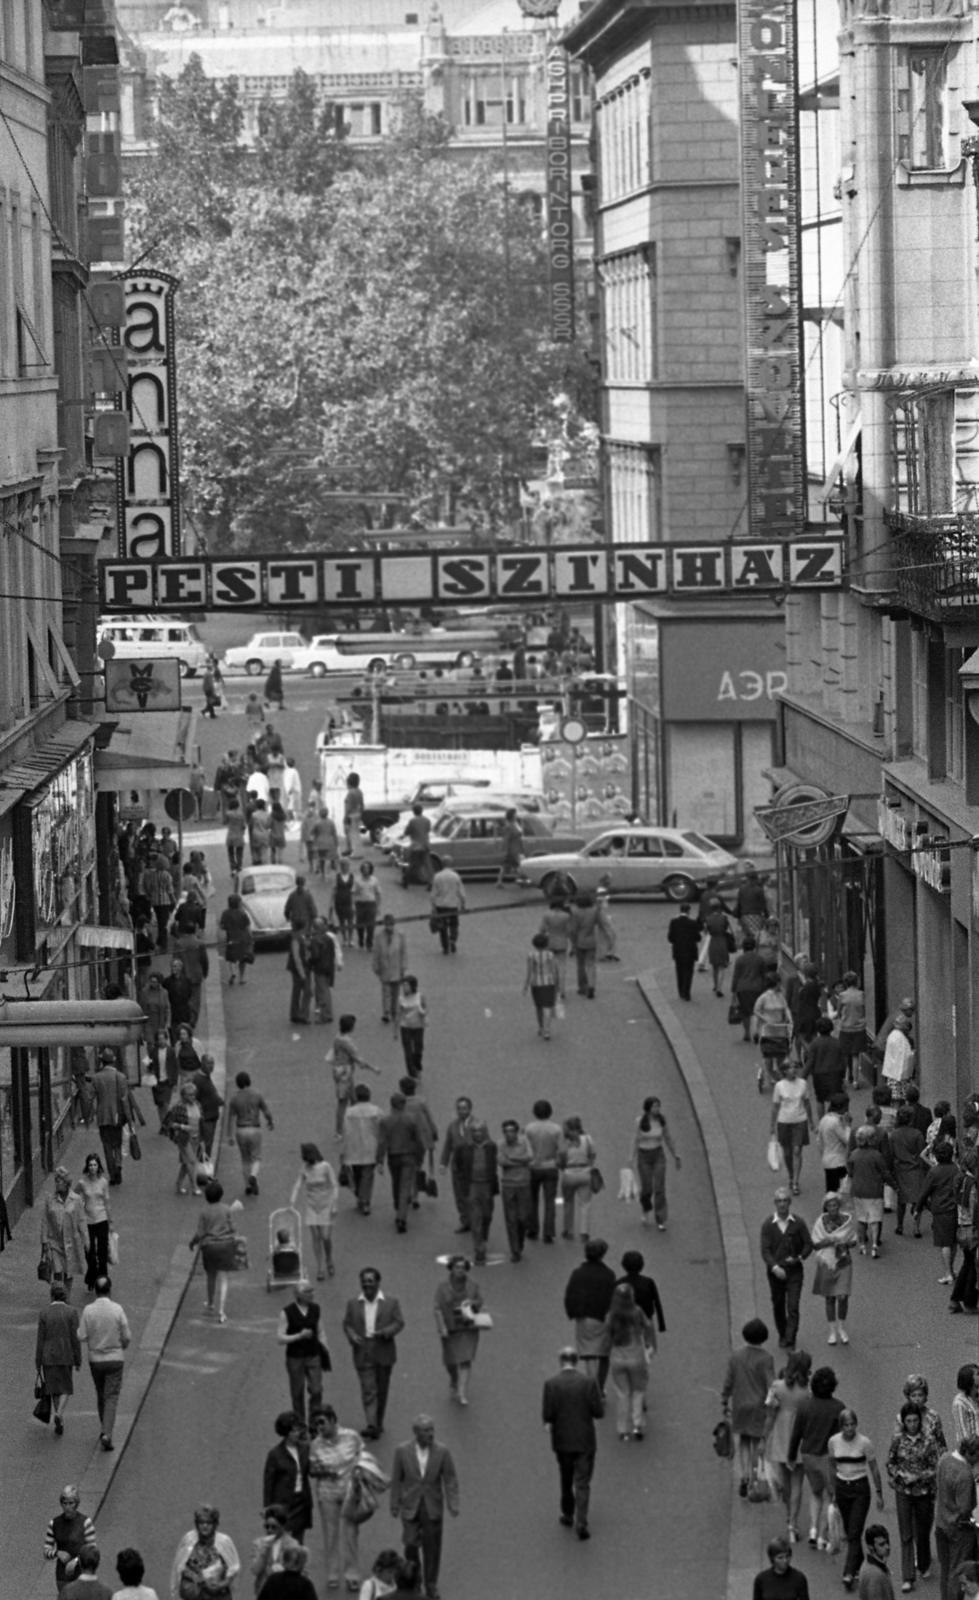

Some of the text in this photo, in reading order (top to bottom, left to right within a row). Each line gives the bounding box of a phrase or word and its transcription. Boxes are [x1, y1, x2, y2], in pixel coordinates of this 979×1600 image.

[552, 282, 572, 341] SSSR
[124, 302, 167, 557] anna
[107, 548, 834, 605] PESTI SZÍNHÁZ
